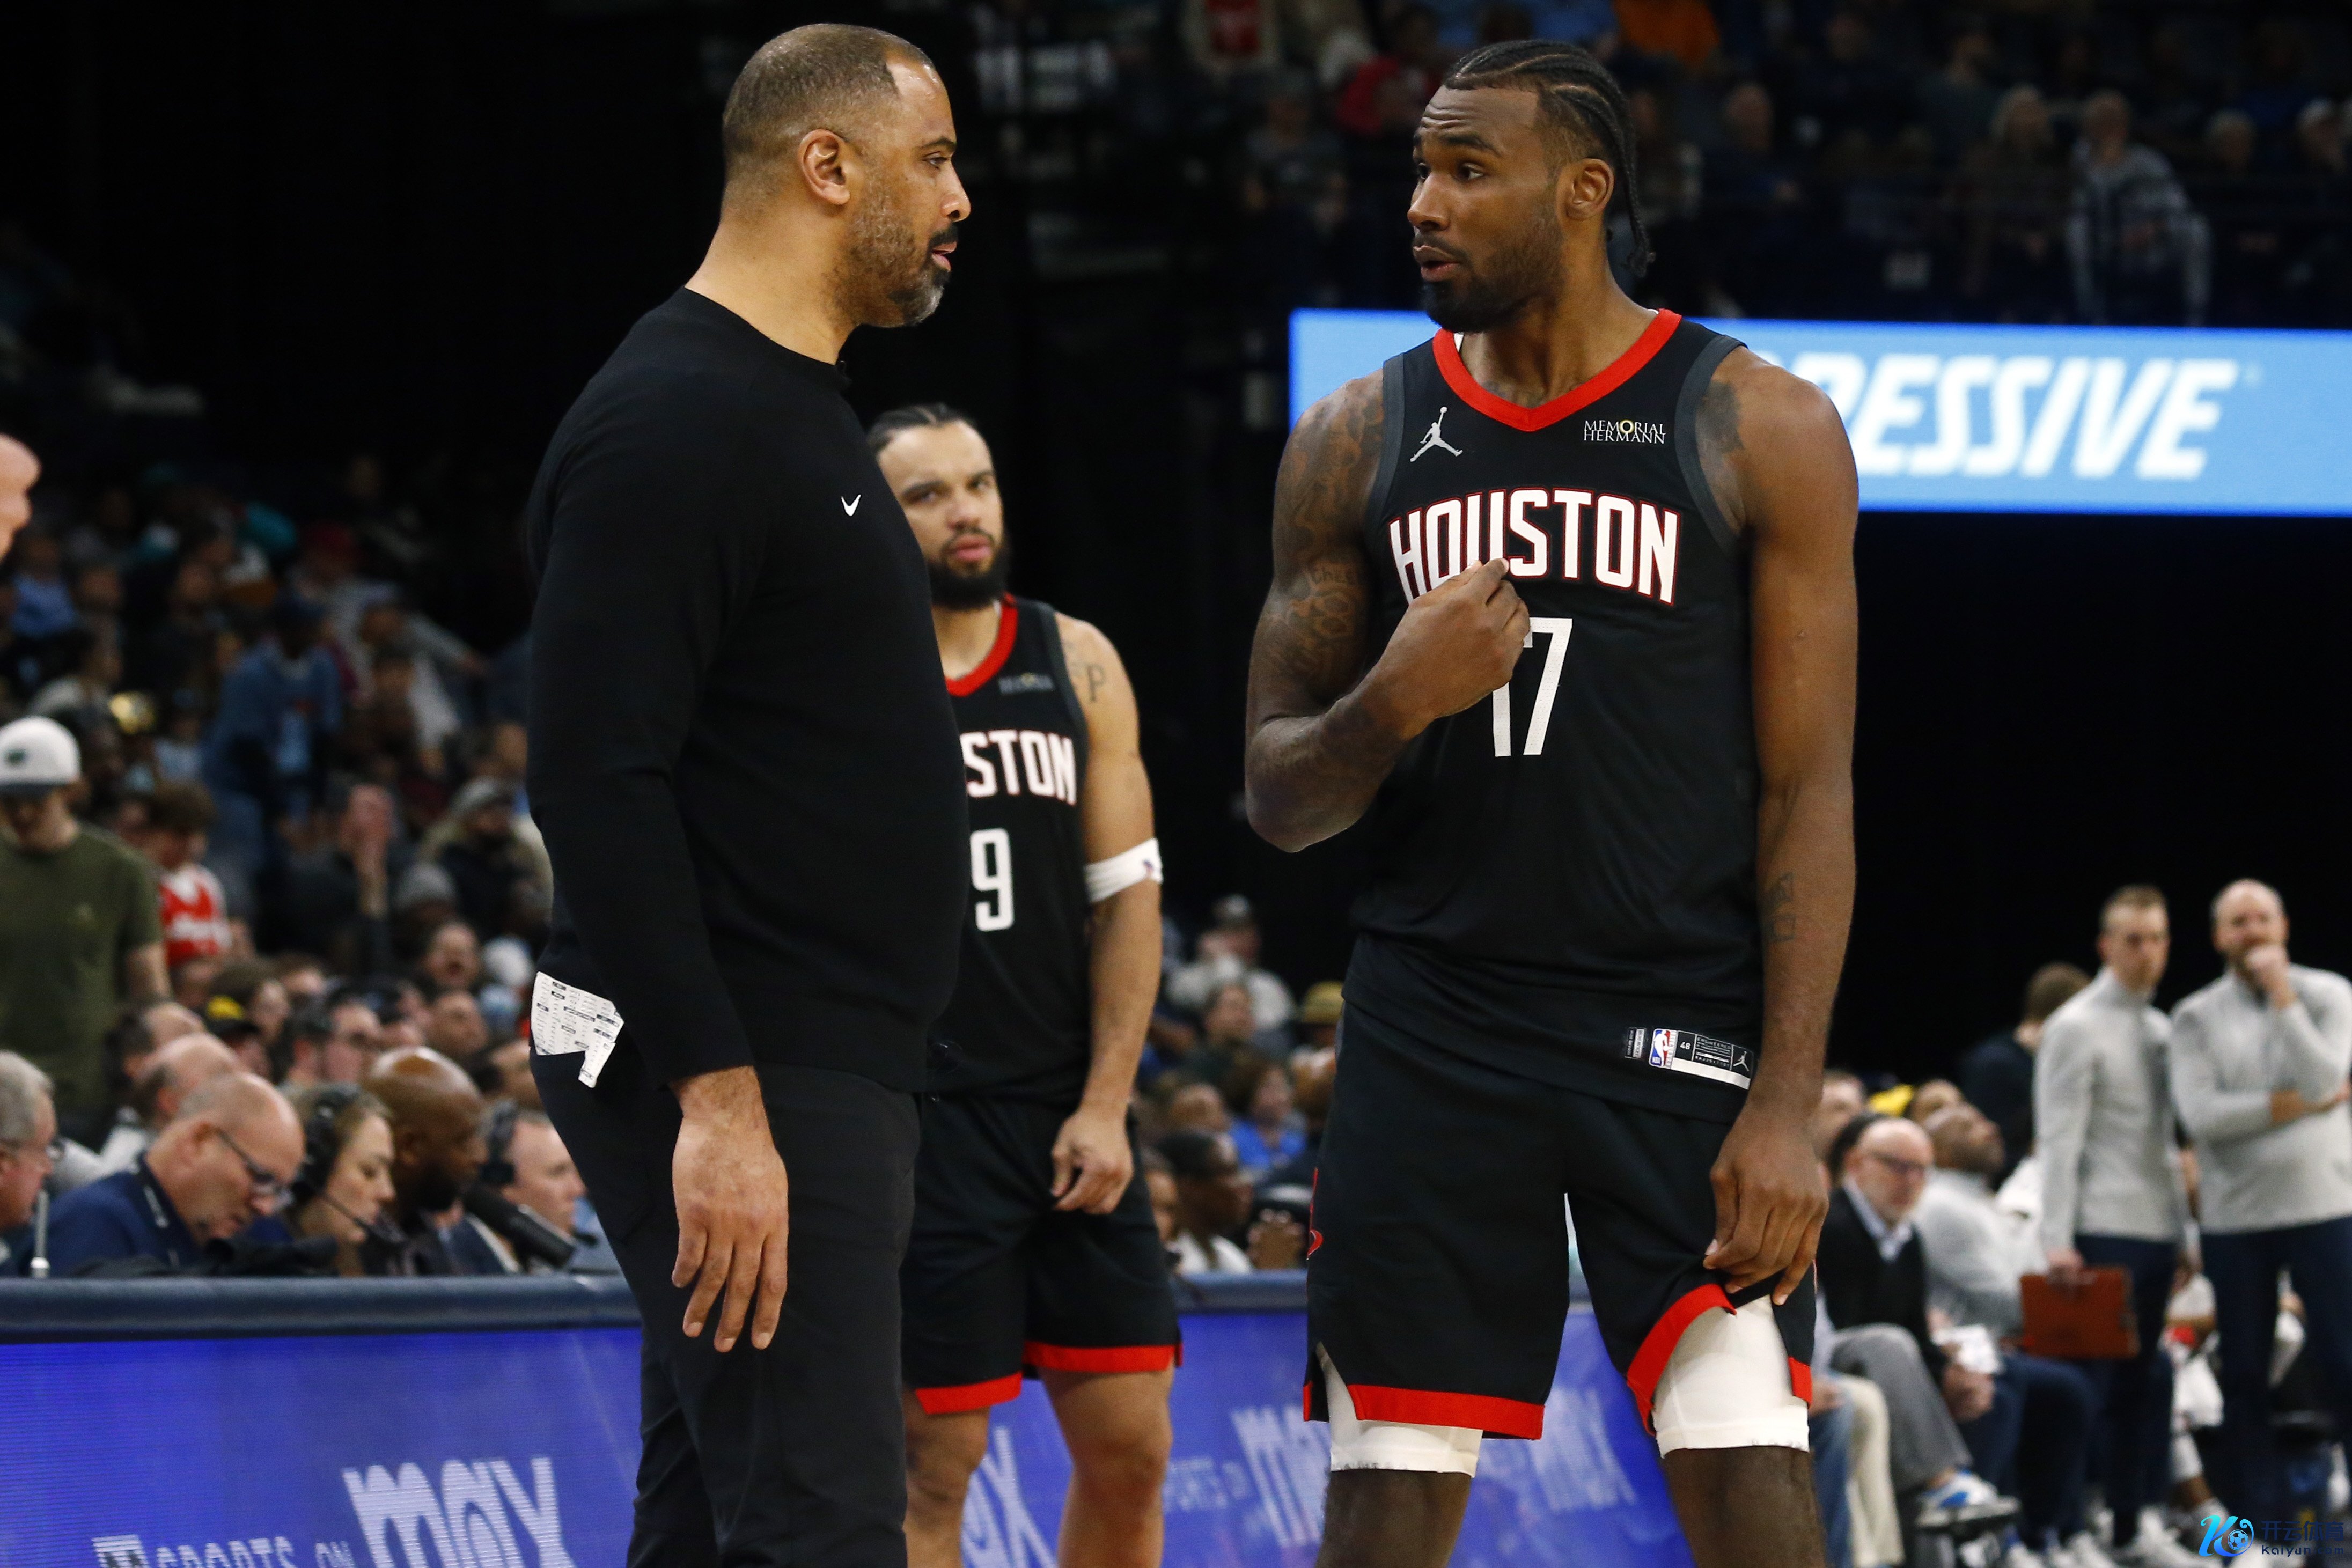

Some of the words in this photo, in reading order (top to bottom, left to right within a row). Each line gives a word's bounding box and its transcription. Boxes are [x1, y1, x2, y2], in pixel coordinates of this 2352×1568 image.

[1584, 419, 1666, 435] MEMORIAL
[1584, 430, 1665, 444] HERMANN
[1762, 352, 2239, 480] RESSIVE
[1389, 487, 1680, 606] HOUSTON
[969, 828, 1014, 932] 9
[1680, 1042, 1691, 1050] 48
